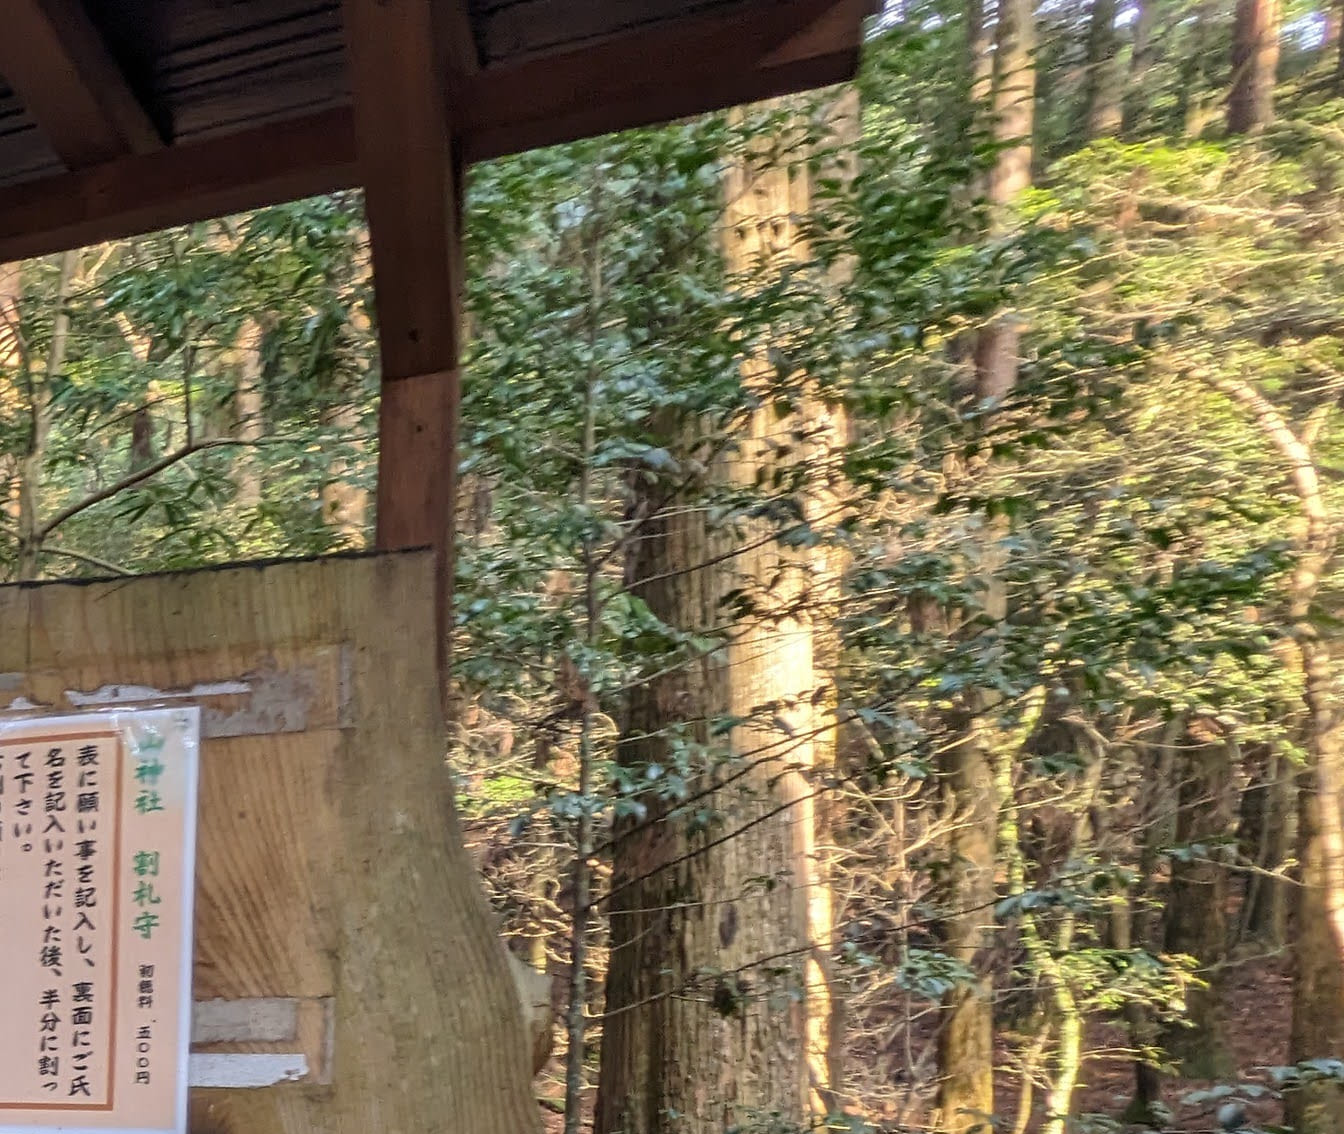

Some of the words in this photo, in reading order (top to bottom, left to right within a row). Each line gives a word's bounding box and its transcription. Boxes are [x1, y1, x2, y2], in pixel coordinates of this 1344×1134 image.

[12, 750, 34, 854] て下さい。
[134, 733, 166, 813] 山神社
[38, 747, 67, 1092] 名を記入いただいた後、半分に割っ
[68, 744, 101, 1097] 表に願い事を記入し、裏面にご氏
[132, 850, 161, 939] 割札守
